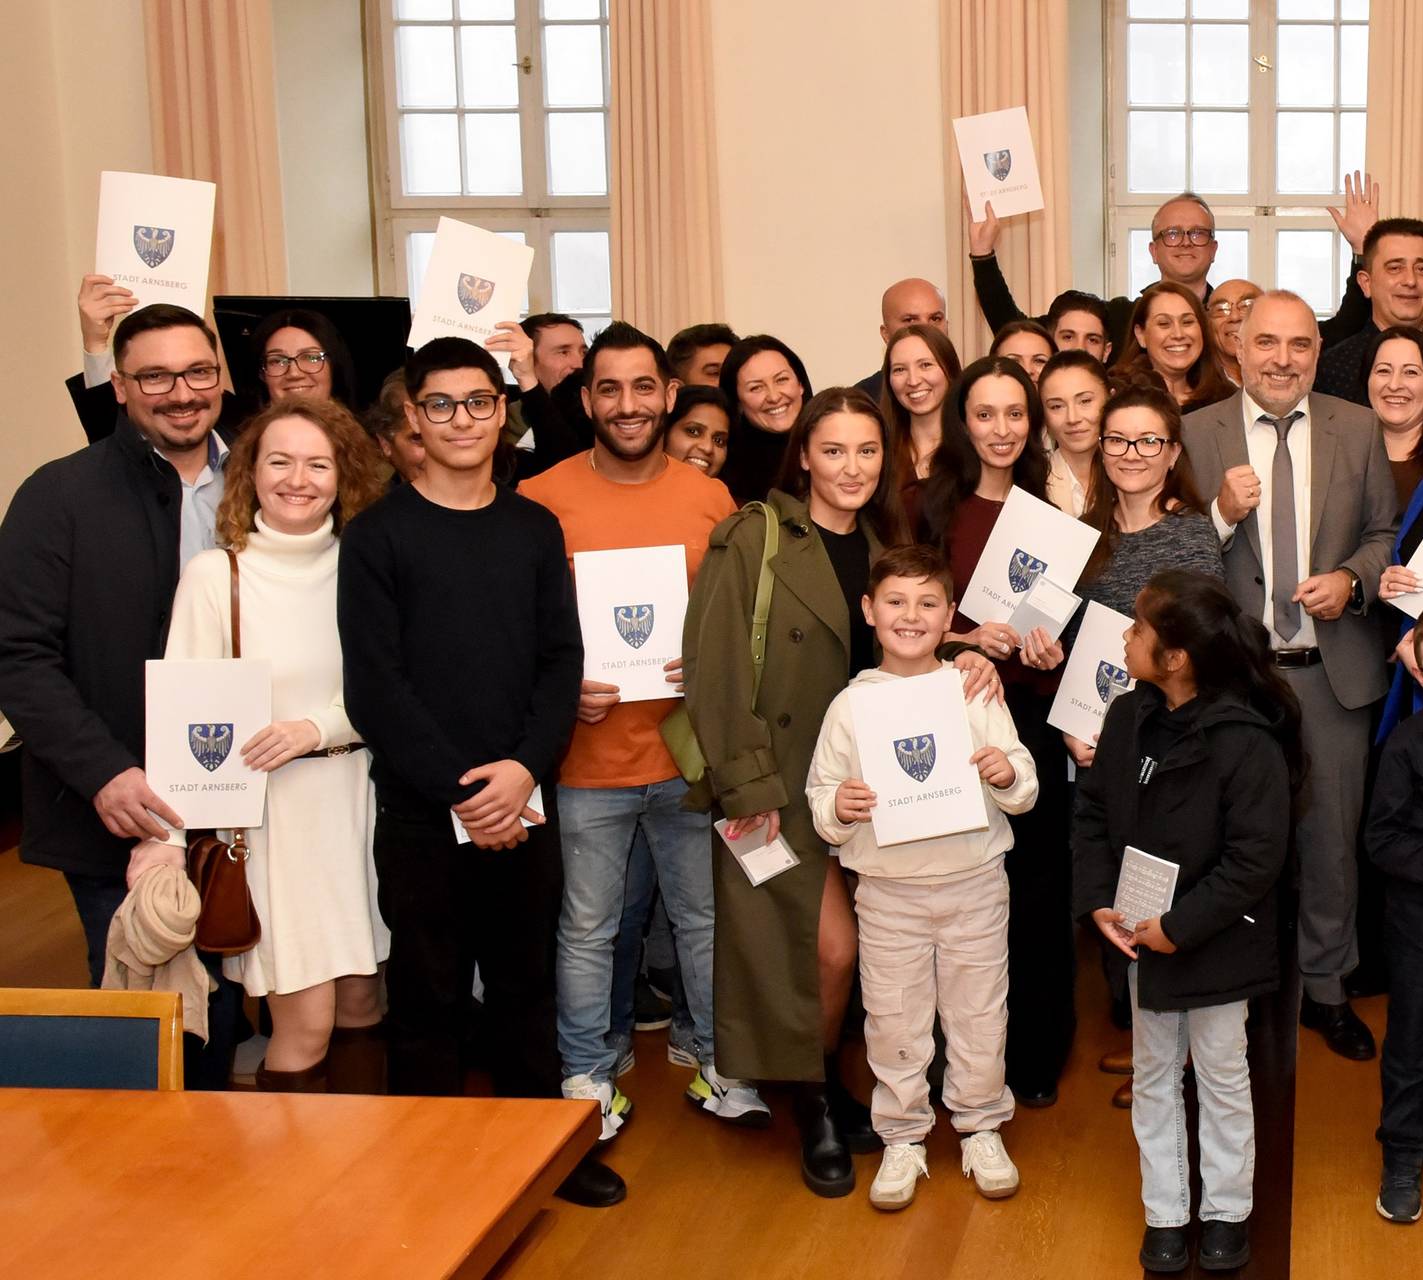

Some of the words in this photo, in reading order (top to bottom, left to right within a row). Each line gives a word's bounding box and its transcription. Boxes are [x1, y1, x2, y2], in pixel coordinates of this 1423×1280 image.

[113, 273, 140, 283] STADT
[141, 277, 188, 290] ARNSBERG
[432, 315, 456, 327] STADT
[982, 586, 1002, 600] STADT
[601, 661, 627, 670] STADT
[1070, 698, 1092, 712] STADT
[169, 783, 199, 793] STADT
[201, 782, 248, 792] ARNSBERG
[887, 796, 914, 808] STADT
[916, 786, 962, 801] ARNSBERG
